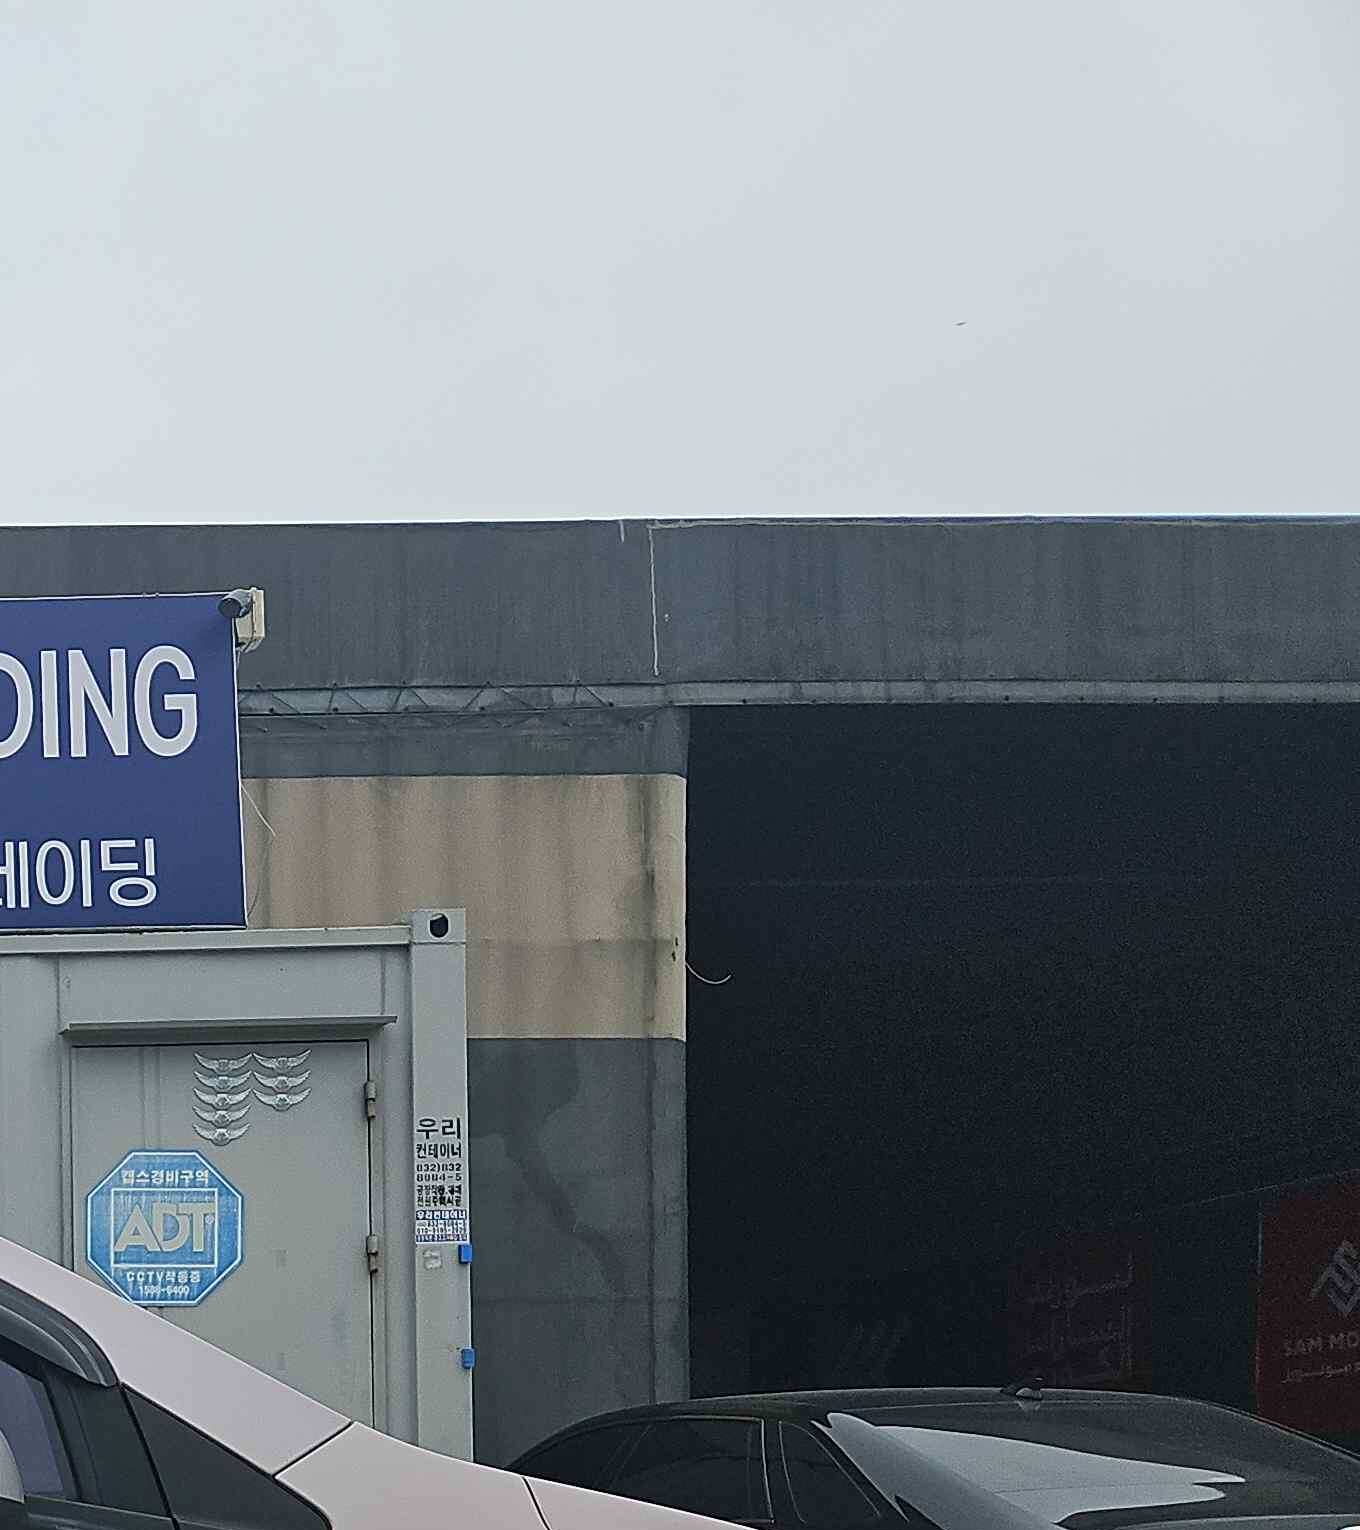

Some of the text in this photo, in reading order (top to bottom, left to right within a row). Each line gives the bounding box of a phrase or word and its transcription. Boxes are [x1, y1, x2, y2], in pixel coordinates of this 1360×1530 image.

[416, 1117, 461, 1140] 우리
[415, 1143, 462, 1160] 컨테이너
[114, 1202, 215, 1252] ADT
